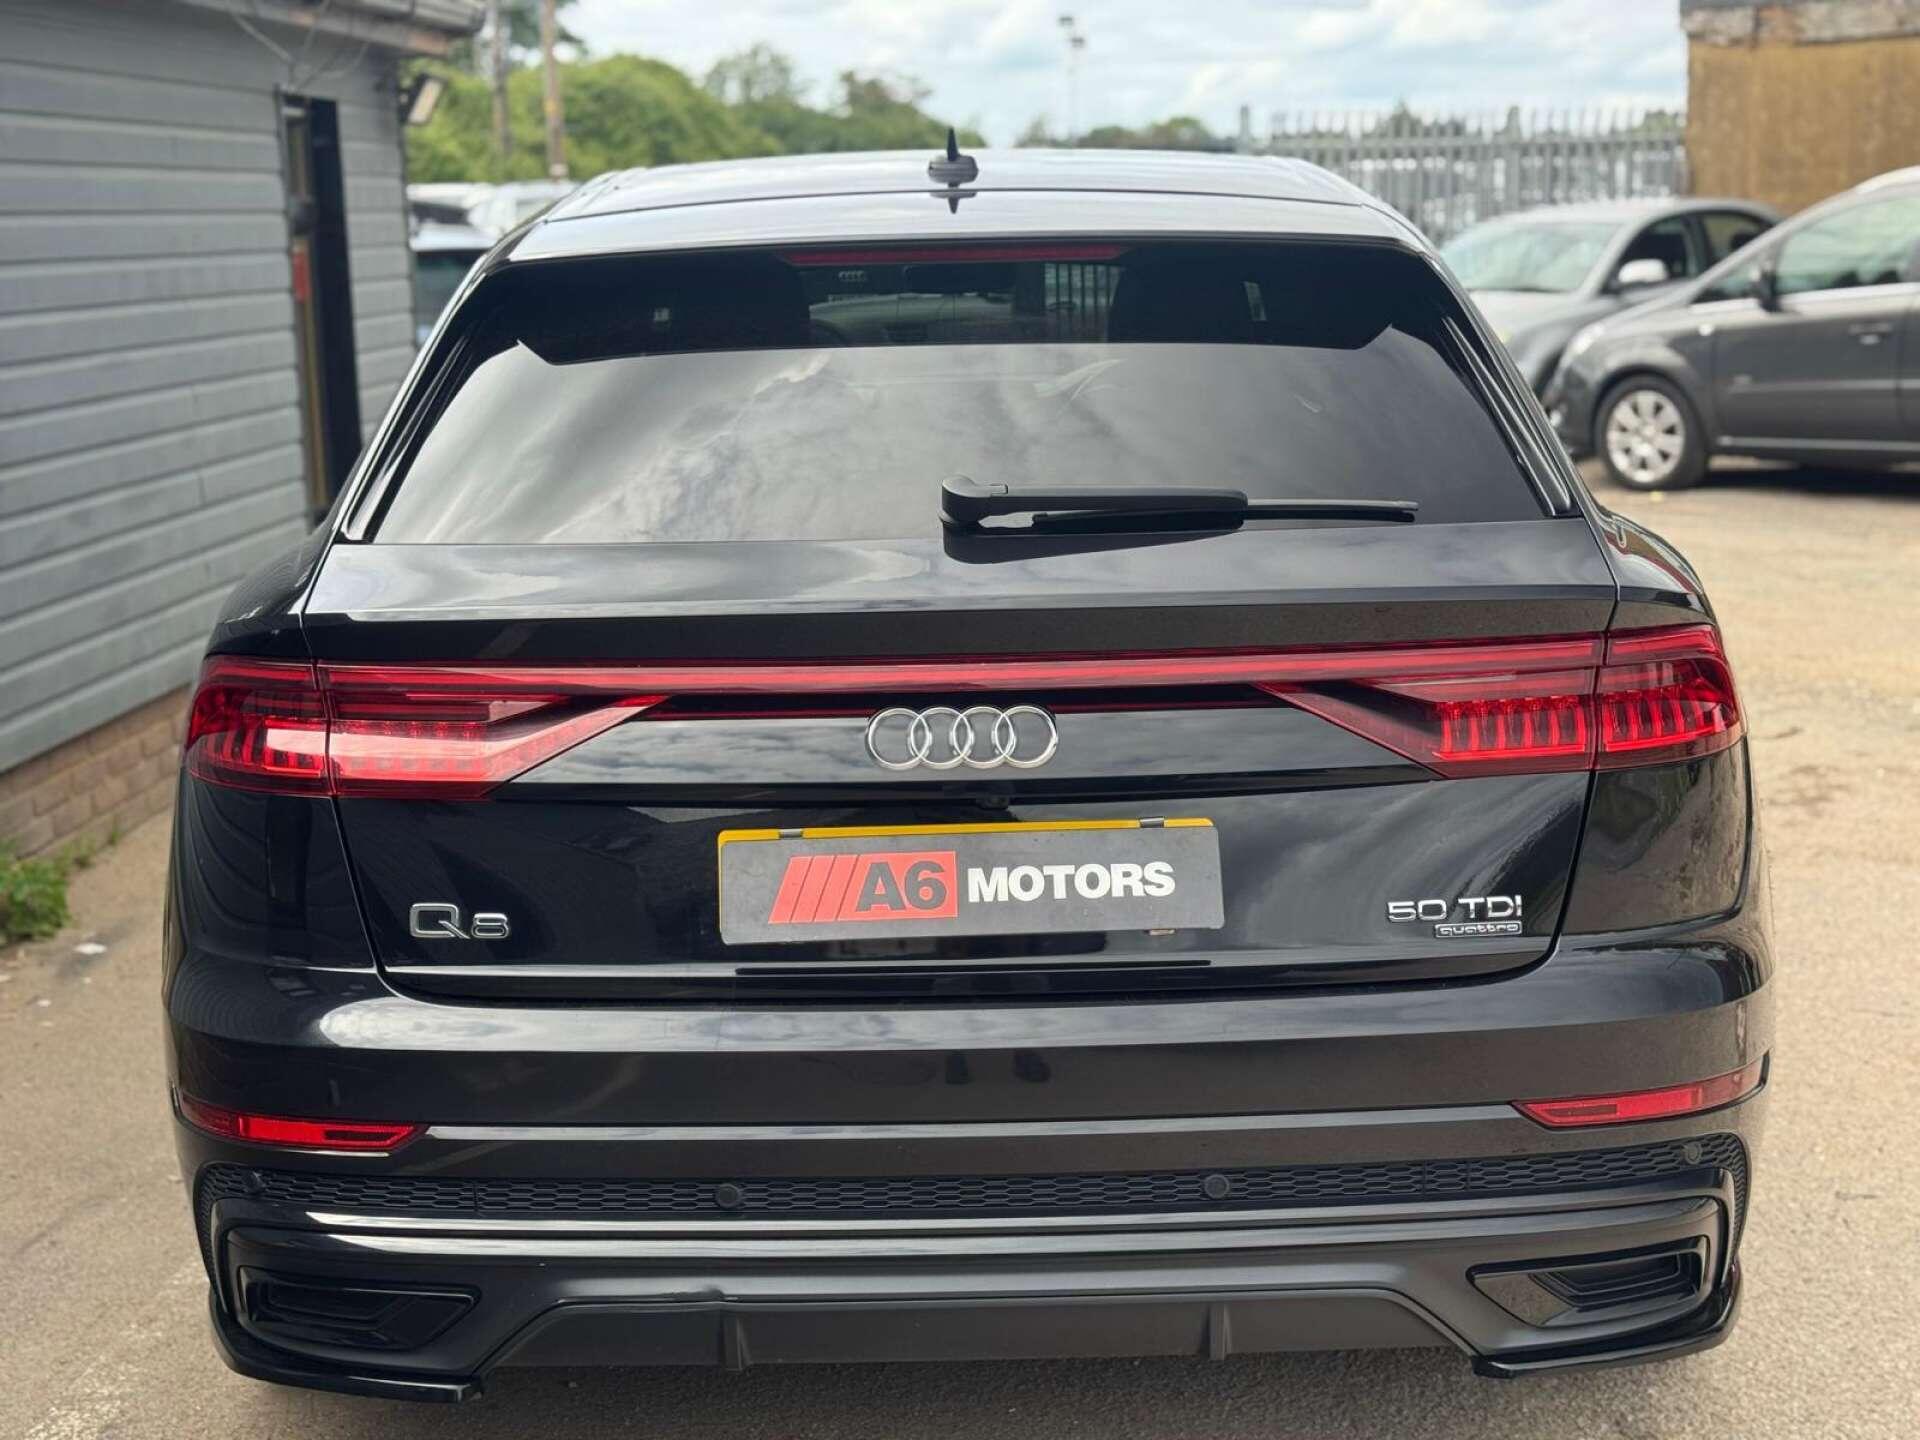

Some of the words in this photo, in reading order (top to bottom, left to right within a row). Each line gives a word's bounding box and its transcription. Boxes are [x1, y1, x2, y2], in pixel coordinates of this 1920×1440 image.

[855, 860, 948, 912] A6
[967, 861, 1176, 904] MOTORS
[409, 902, 509, 939] Q8
[1387, 899, 1448, 922] 50
[1458, 895, 1523, 919] TDI
[1439, 923, 1519, 936] quattro
